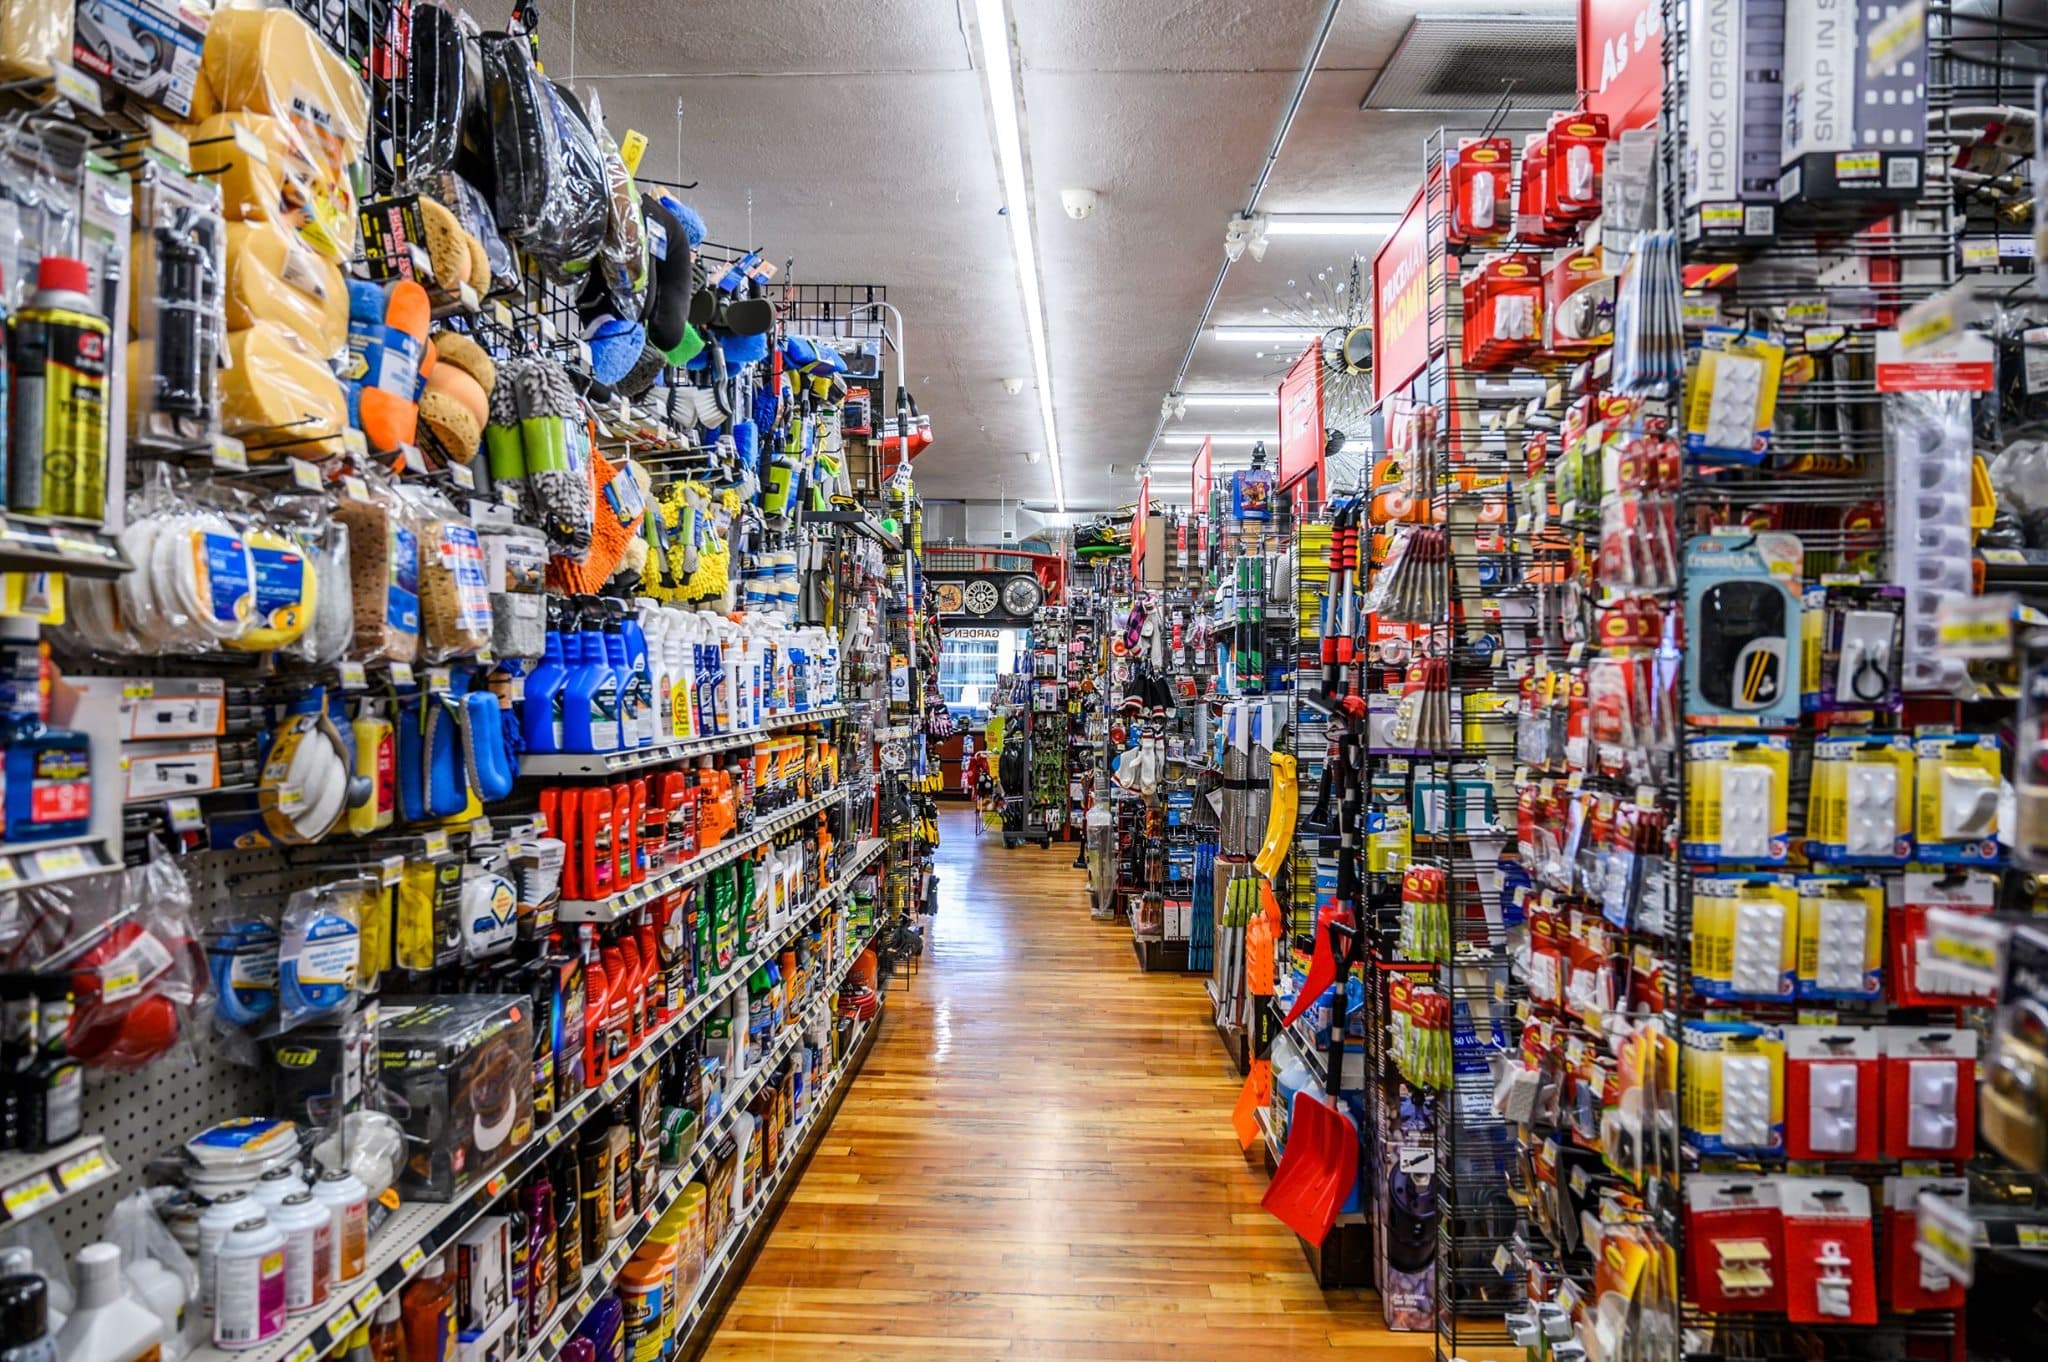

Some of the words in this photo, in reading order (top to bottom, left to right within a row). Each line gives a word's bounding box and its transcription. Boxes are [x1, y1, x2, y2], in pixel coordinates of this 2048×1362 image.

[1600, 31, 1628, 95] As
[1817, 20, 1836, 48] IN
[1815, 59, 1834, 142] SNAP
[1708, 111, 1725, 191] HOOK
